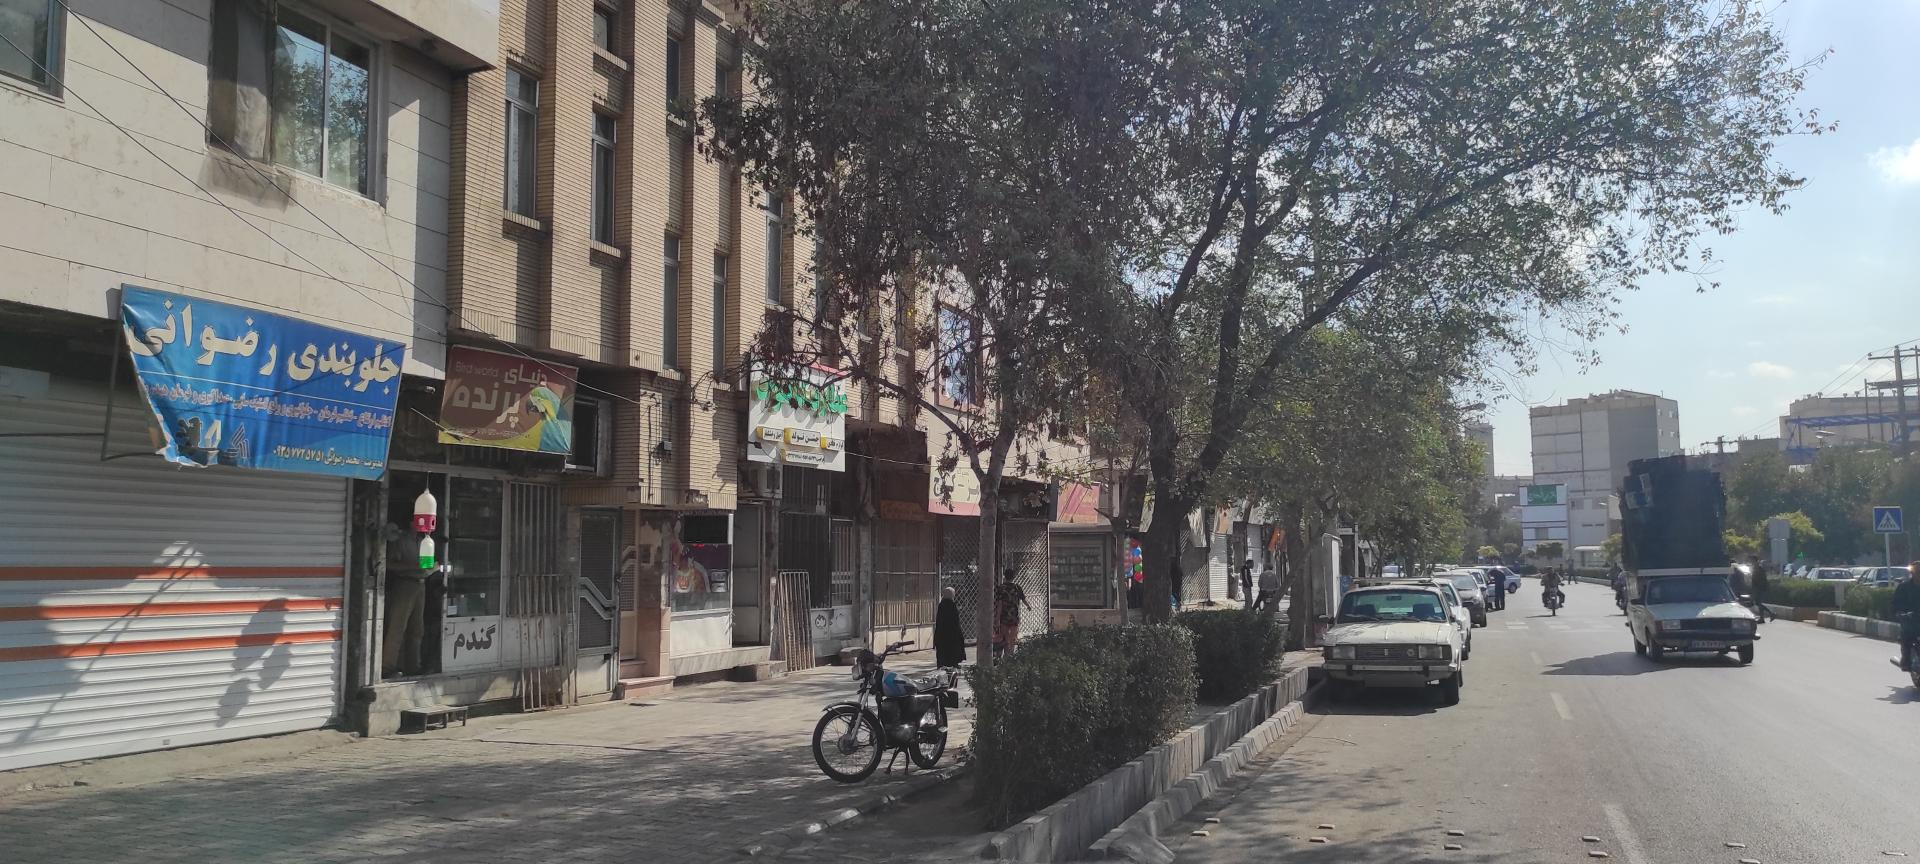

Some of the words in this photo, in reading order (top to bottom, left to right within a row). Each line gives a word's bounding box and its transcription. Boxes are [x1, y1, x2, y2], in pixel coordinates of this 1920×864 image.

[287, 342, 400, 395] جلوبندی
[504, 364, 547, 388] دنیای
[451, 382, 521, 428] پرنده
[454, 624, 496, 660] گندم
